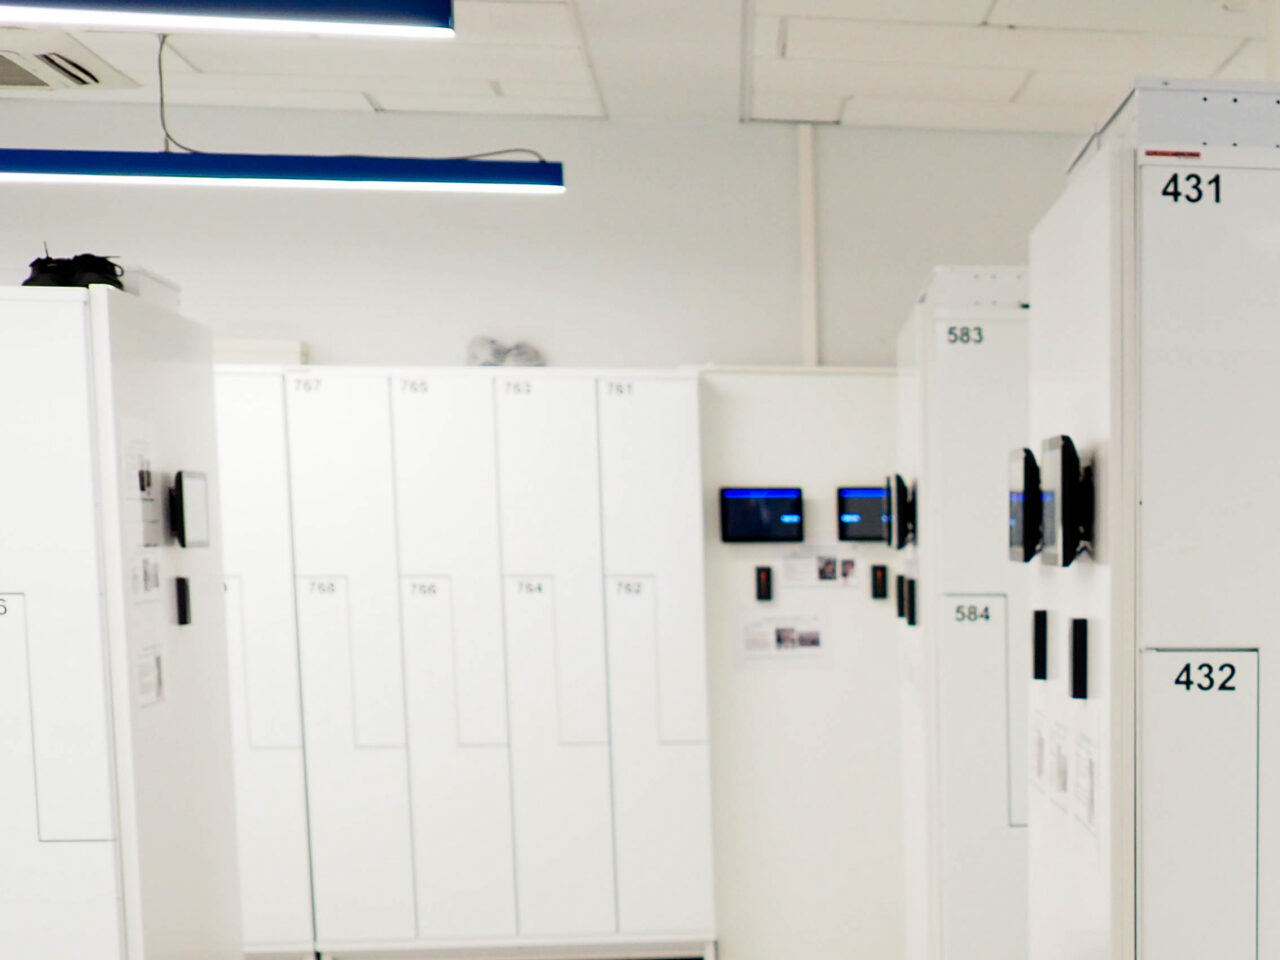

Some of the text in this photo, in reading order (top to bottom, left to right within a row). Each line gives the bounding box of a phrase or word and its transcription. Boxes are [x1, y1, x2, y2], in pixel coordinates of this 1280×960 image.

[1162, 172, 1221, 204] 431
[947, 326, 984, 344] 583
[293, 381, 322, 393] 767
[516, 582, 544, 595] 764
[955, 605, 990, 622] 584
[1174, 662, 1236, 691] 432
